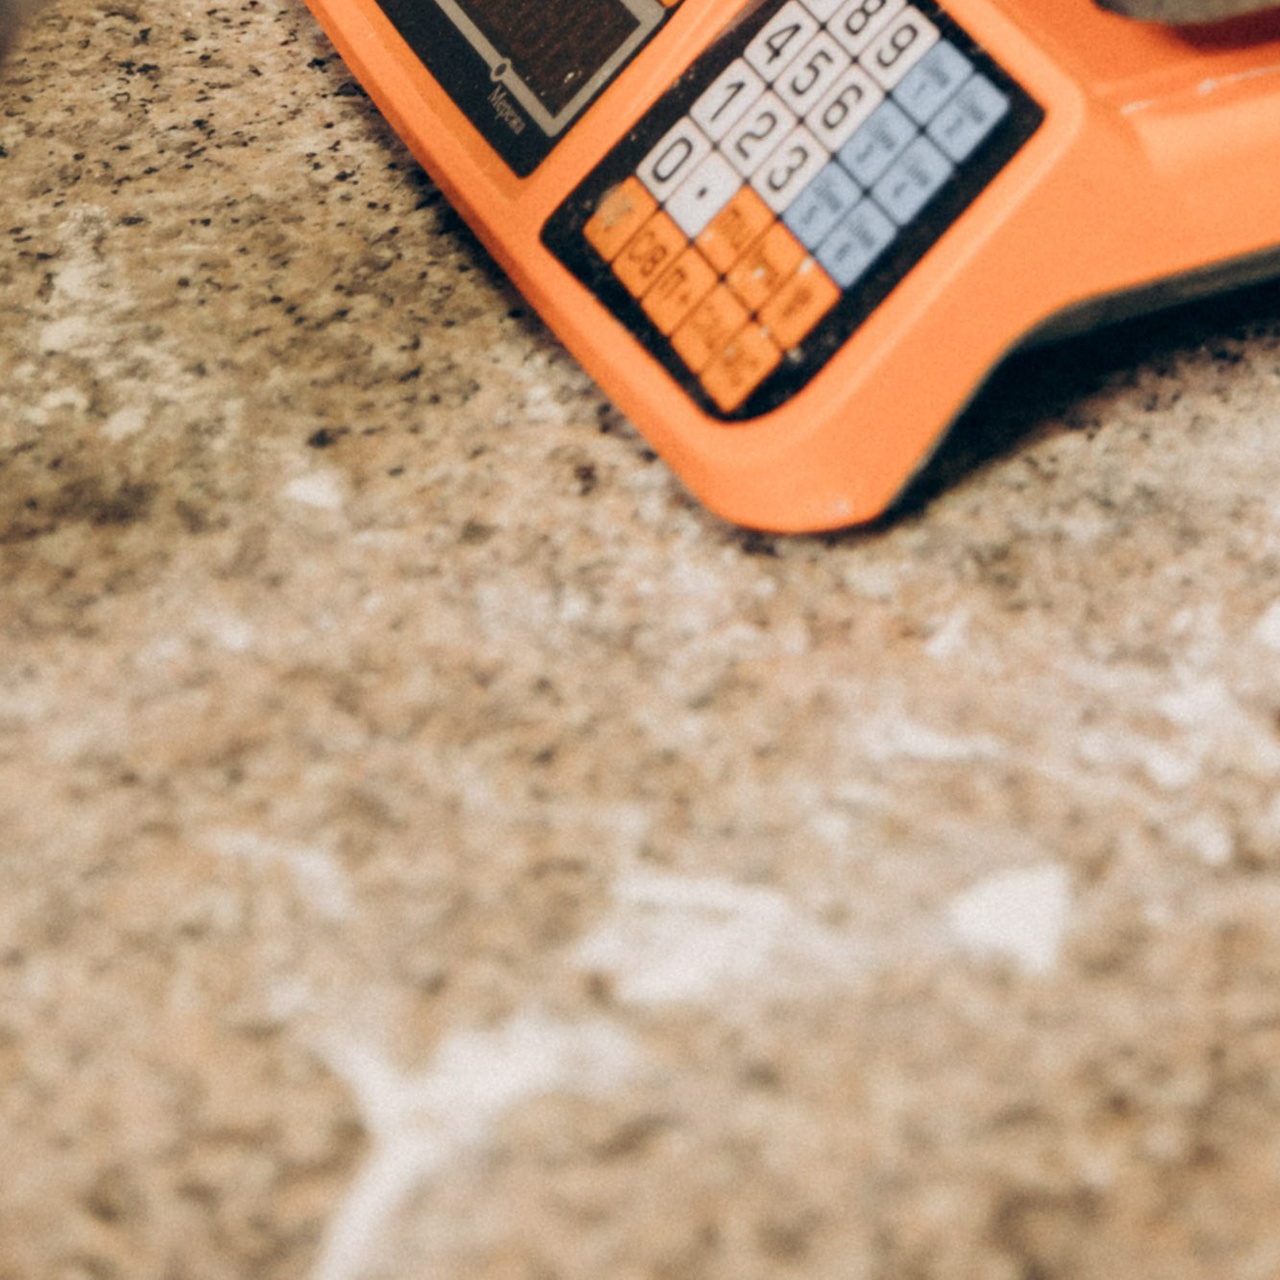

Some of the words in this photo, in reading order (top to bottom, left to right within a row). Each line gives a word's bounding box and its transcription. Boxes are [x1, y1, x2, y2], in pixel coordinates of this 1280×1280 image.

[763, 23, 802, 65] 4
[875, 23, 918, 69] 9
[791, 51, 834, 96] 5
[710, 80, 747, 122] 1
[821, 84, 863, 131] 6
[733, 111, 777, 160] 2
[651, 137, 694, 183] 0
[767, 145, 809, 192] 3
